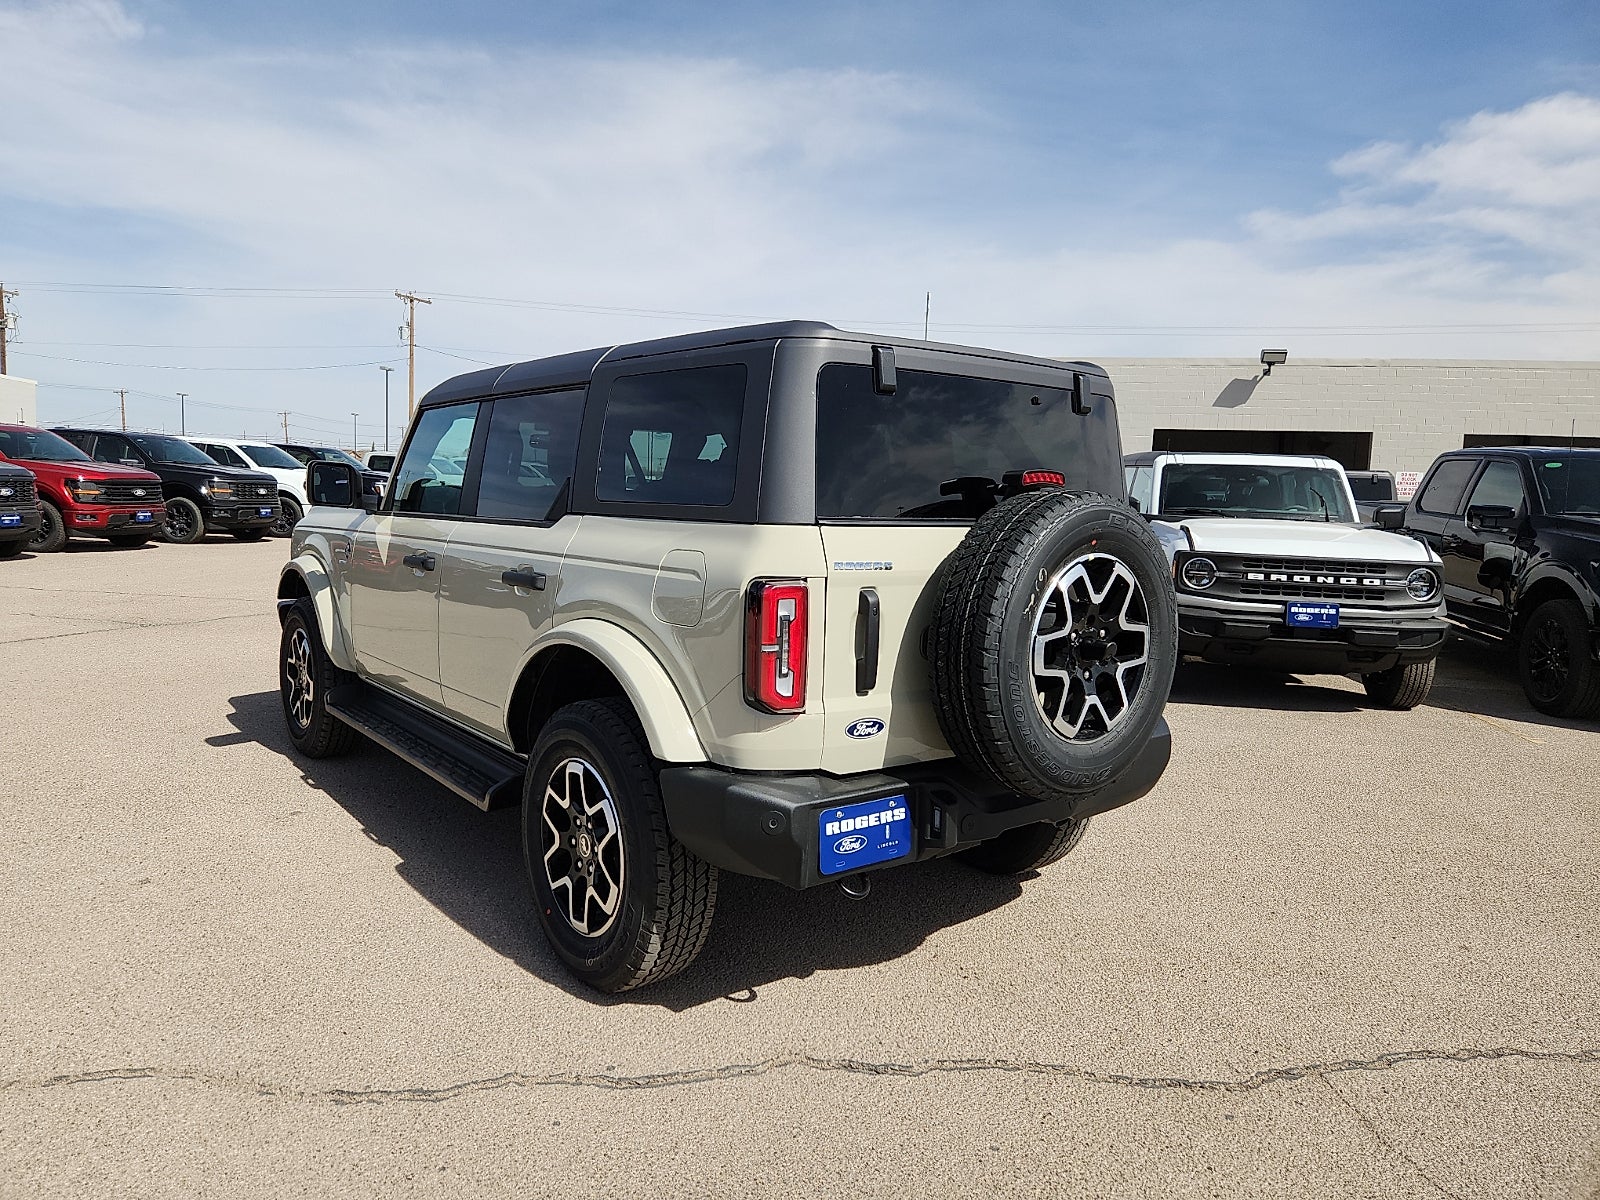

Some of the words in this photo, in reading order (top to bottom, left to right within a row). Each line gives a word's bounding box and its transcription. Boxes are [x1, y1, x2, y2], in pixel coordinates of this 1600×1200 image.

[1247, 573, 1381, 586] BRONCO
[1291, 606, 1337, 615] ROGERS
[851, 721, 880, 737] Ford
[1008, 659, 1113, 785] BRIDGESTONE
[825, 807, 906, 836] ROGERS
[838, 836, 863, 852] Ford
[877, 840, 899, 849] LINCOLN
